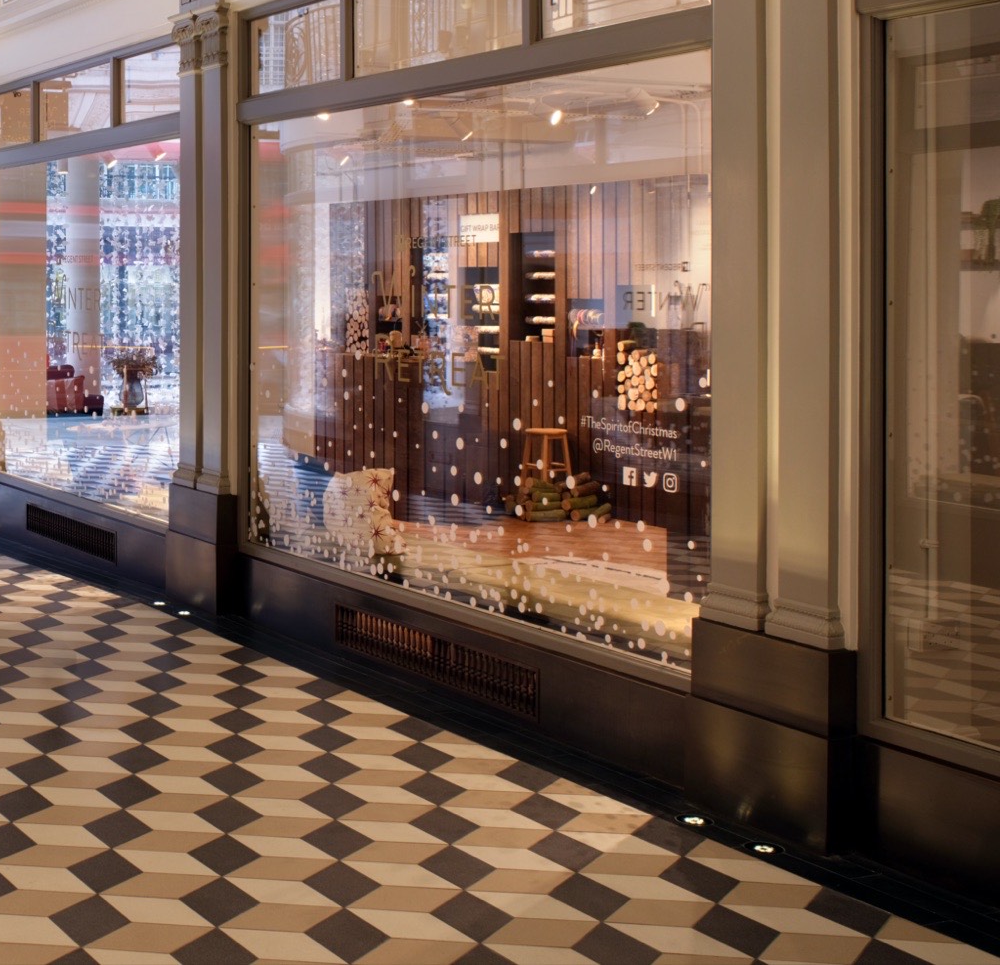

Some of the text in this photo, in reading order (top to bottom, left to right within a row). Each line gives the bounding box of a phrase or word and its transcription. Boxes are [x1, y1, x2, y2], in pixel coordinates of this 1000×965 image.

[473, 223, 489, 232] WRAP
[372, 265, 495, 320] WINTER
[374, 332, 505, 395] RETREAT
[580, 415, 678, 439] #TheSpiritofChristmas
[592, 437, 677, 462] @RegentStreetW1
